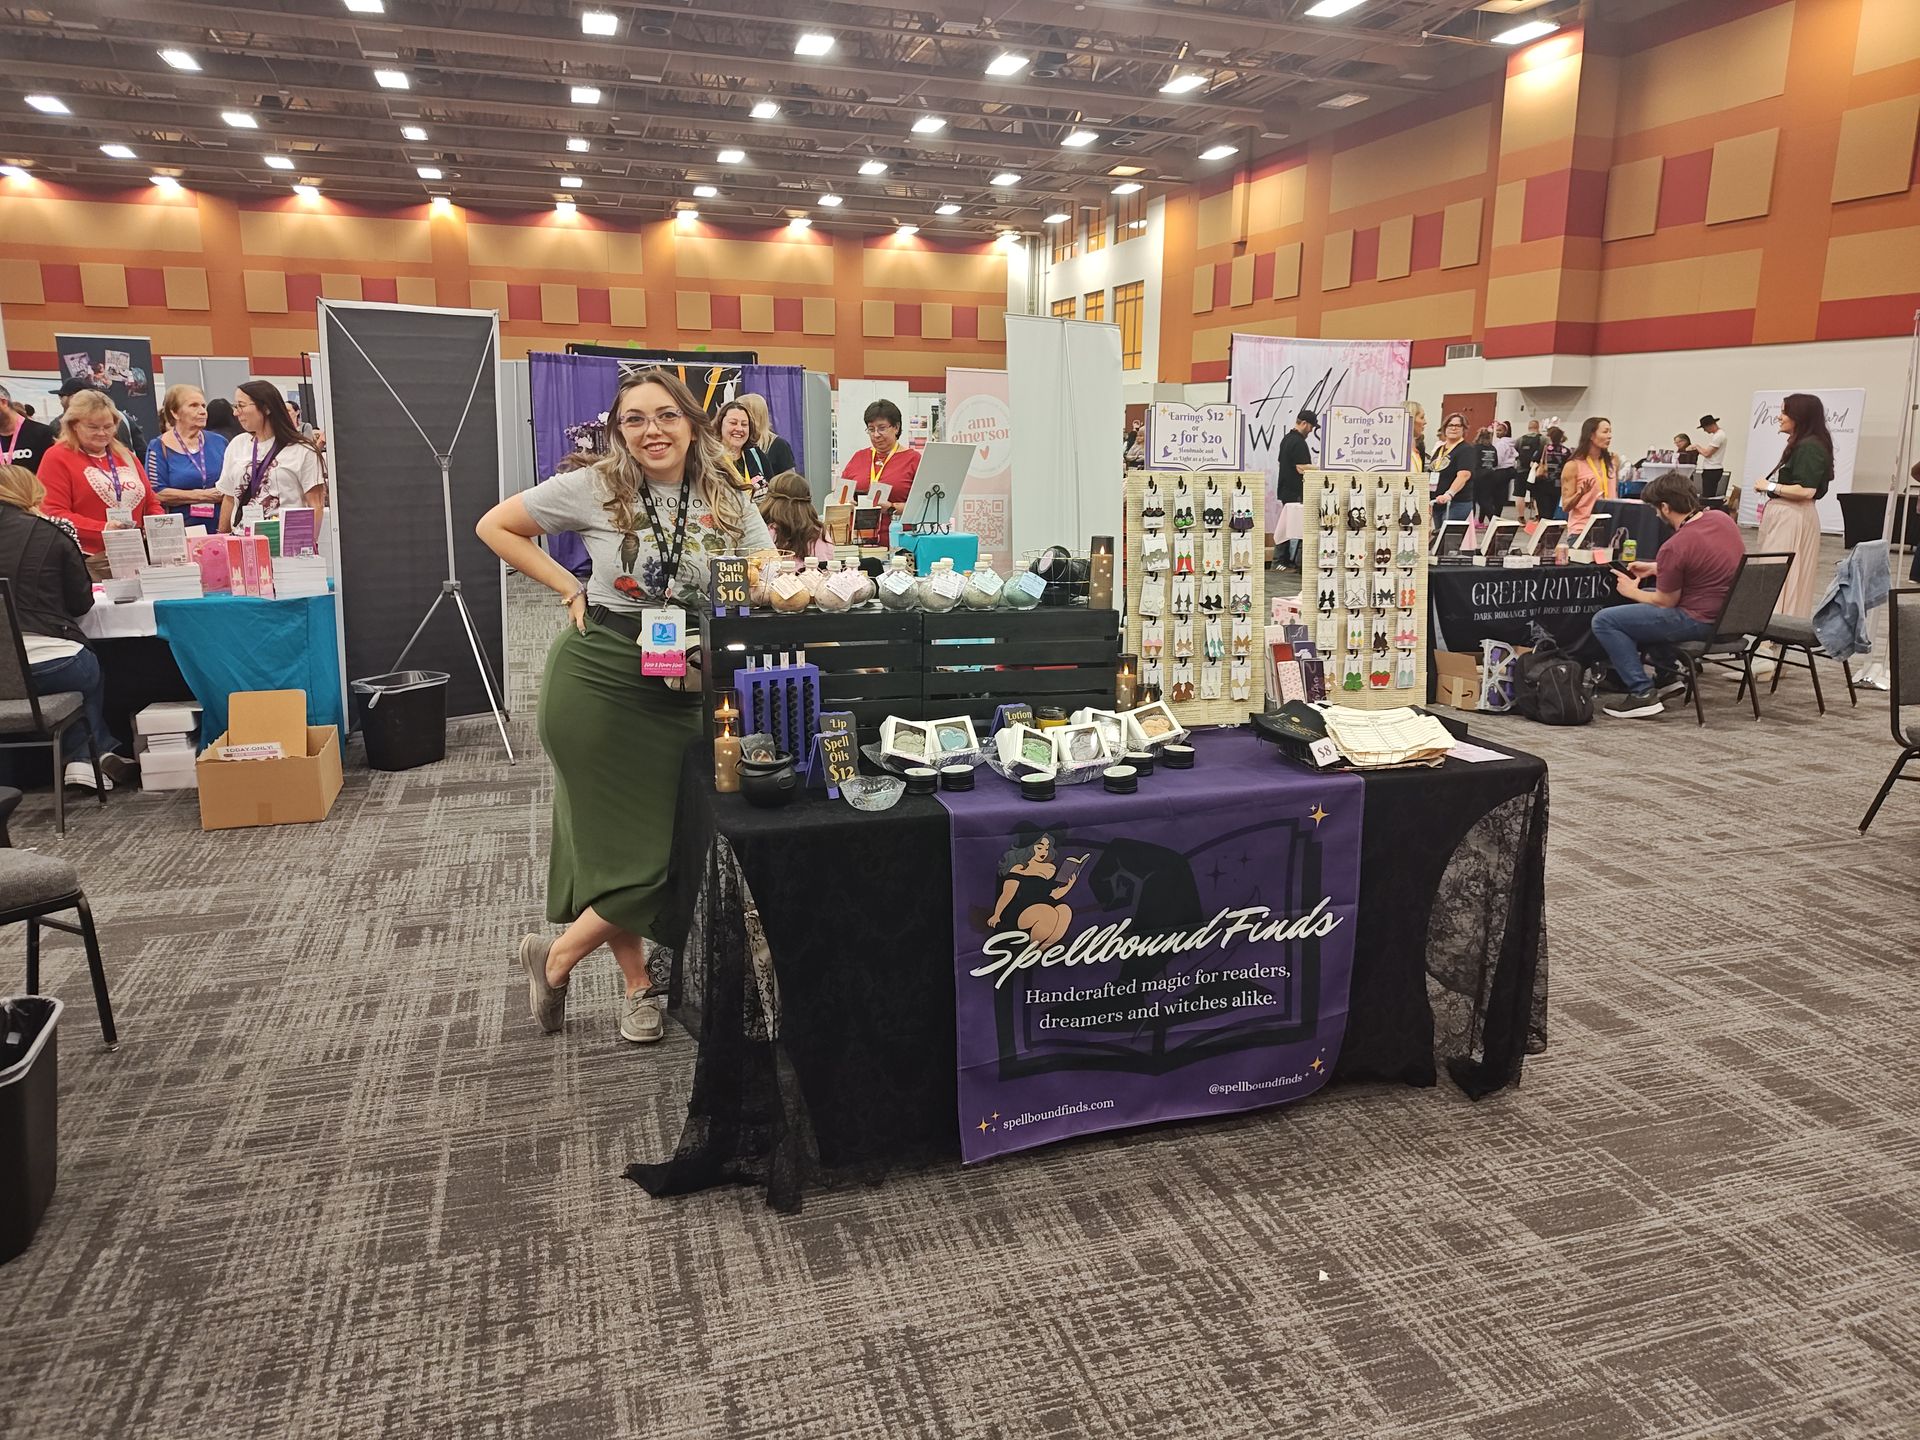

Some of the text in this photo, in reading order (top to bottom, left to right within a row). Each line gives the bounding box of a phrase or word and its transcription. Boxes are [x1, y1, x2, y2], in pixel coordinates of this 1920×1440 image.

[968, 417, 996, 430] ann
[1168, 408, 1224, 424] Earrings $12
[1342, 412, 1394, 426] Earrings $12
[1171, 429, 1222, 446] 2 for $20
[1344, 432, 1391, 448] 2 for $20
[104, 481, 137, 492] XXO
[716, 561, 744, 572] Bath
[718, 572, 744, 583] Salts
[716, 584, 746, 602] $16
[1471, 571, 1612, 608] GREER RIVERS
[1473, 611, 1493, 620] DARK
[1494, 609, 1527, 619] ROMANCE
[1005, 710, 1032, 721] Lotion
[829, 719, 847, 730] Lip
[824, 735, 850, 752] Spell
[829, 750, 850, 763] Oils
[1317, 745, 1333, 759] $8
[828, 763, 856, 785] $12
[970, 896, 1344, 990] Spellbound Finds
[1025, 962, 1291, 1004] Handcrafted magic for readers,
[1039, 990, 1277, 1030] dreamers and witches alike.
[1208, 1073, 1303, 1095] @spellboundfinds
[1003, 1098, 1114, 1129] spellboundfinds.com
